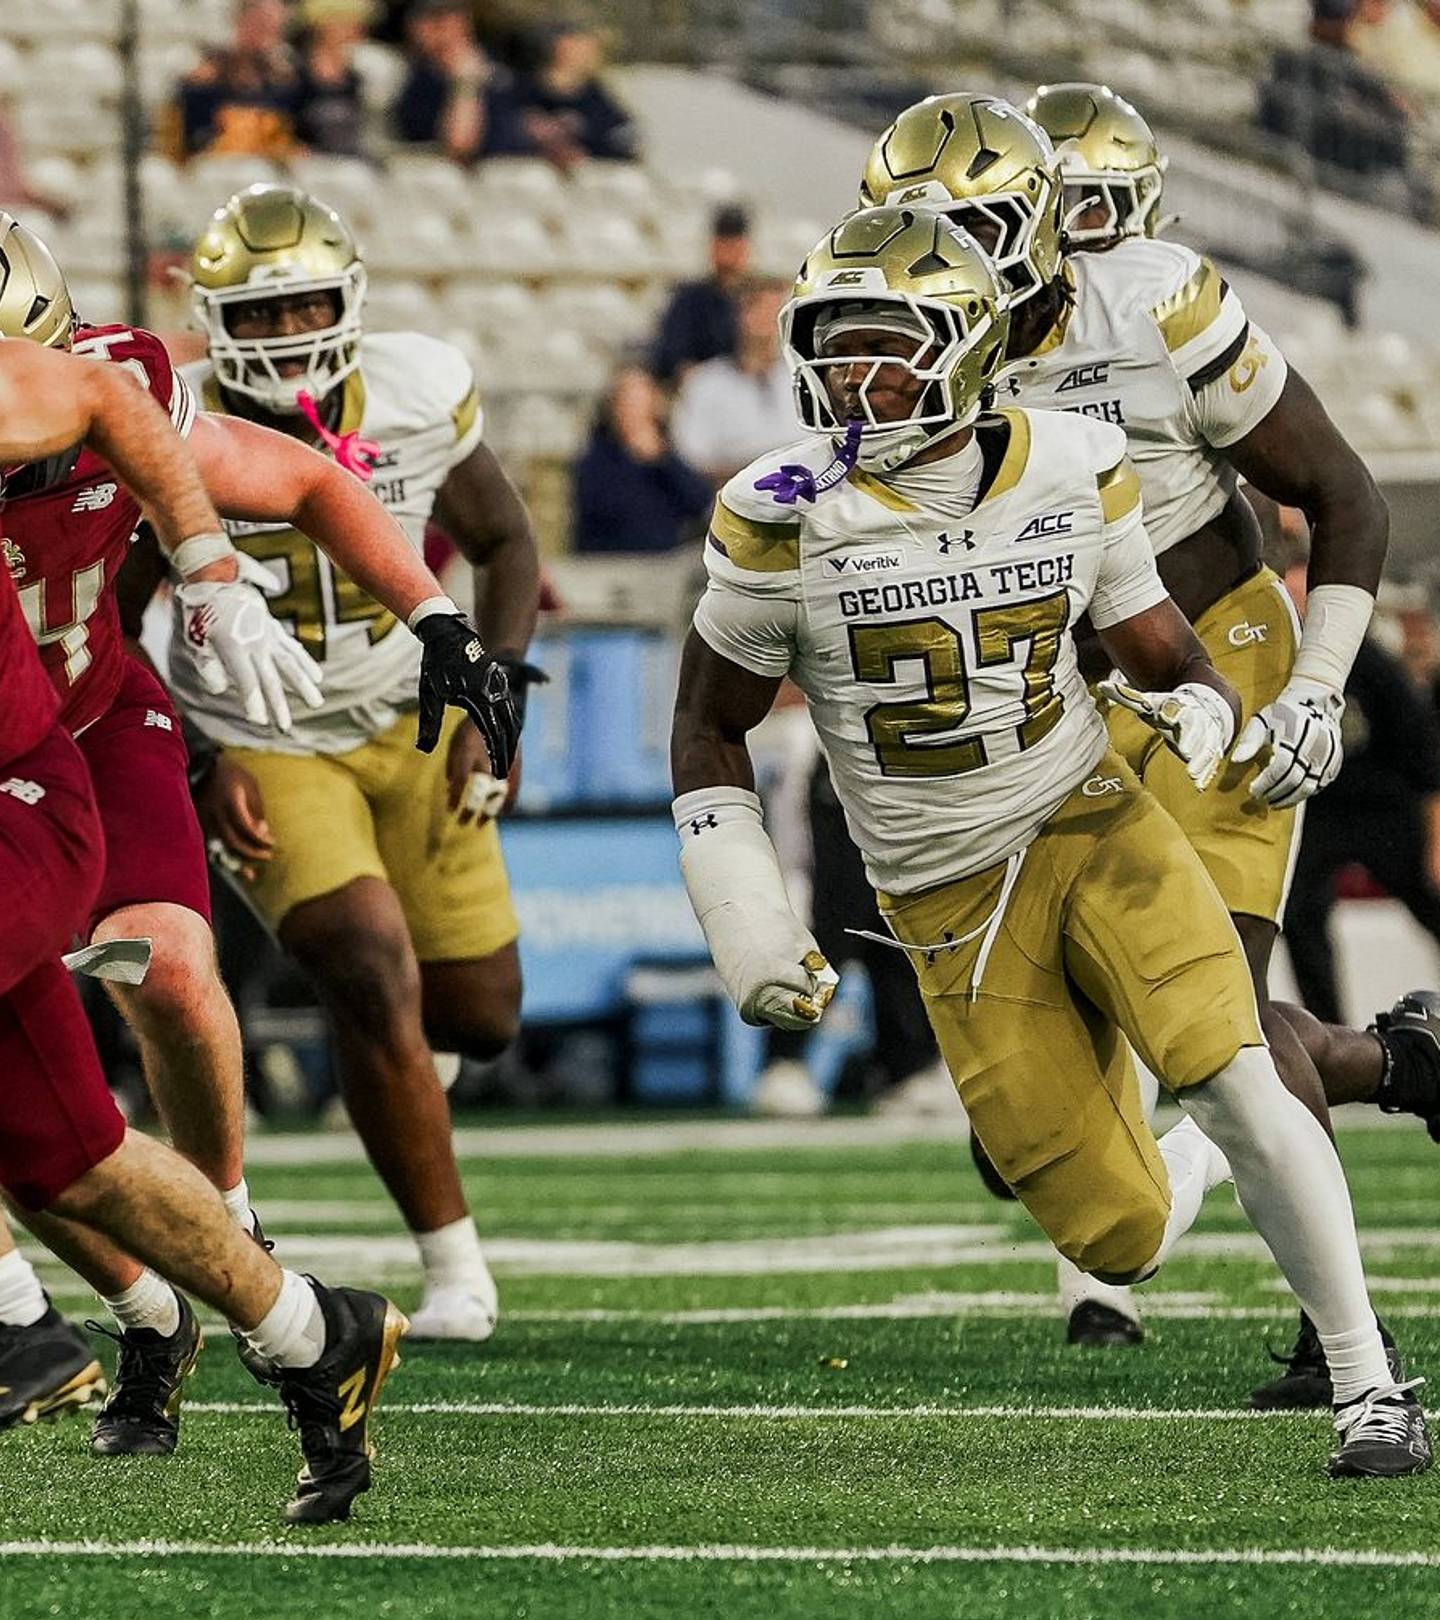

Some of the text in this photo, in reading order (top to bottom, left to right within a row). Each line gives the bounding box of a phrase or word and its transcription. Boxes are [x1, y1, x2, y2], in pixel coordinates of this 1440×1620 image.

[897, 185, 928, 205] ACC
[827, 271, 865, 287] ACC
[1055, 361, 1109, 392] ACC
[1048, 399, 1125, 425] CH
[1014, 512, 1075, 542] ACC
[838, 554, 1075, 618] GEORGIA TECH
[847, 589, 1071, 777] 27
